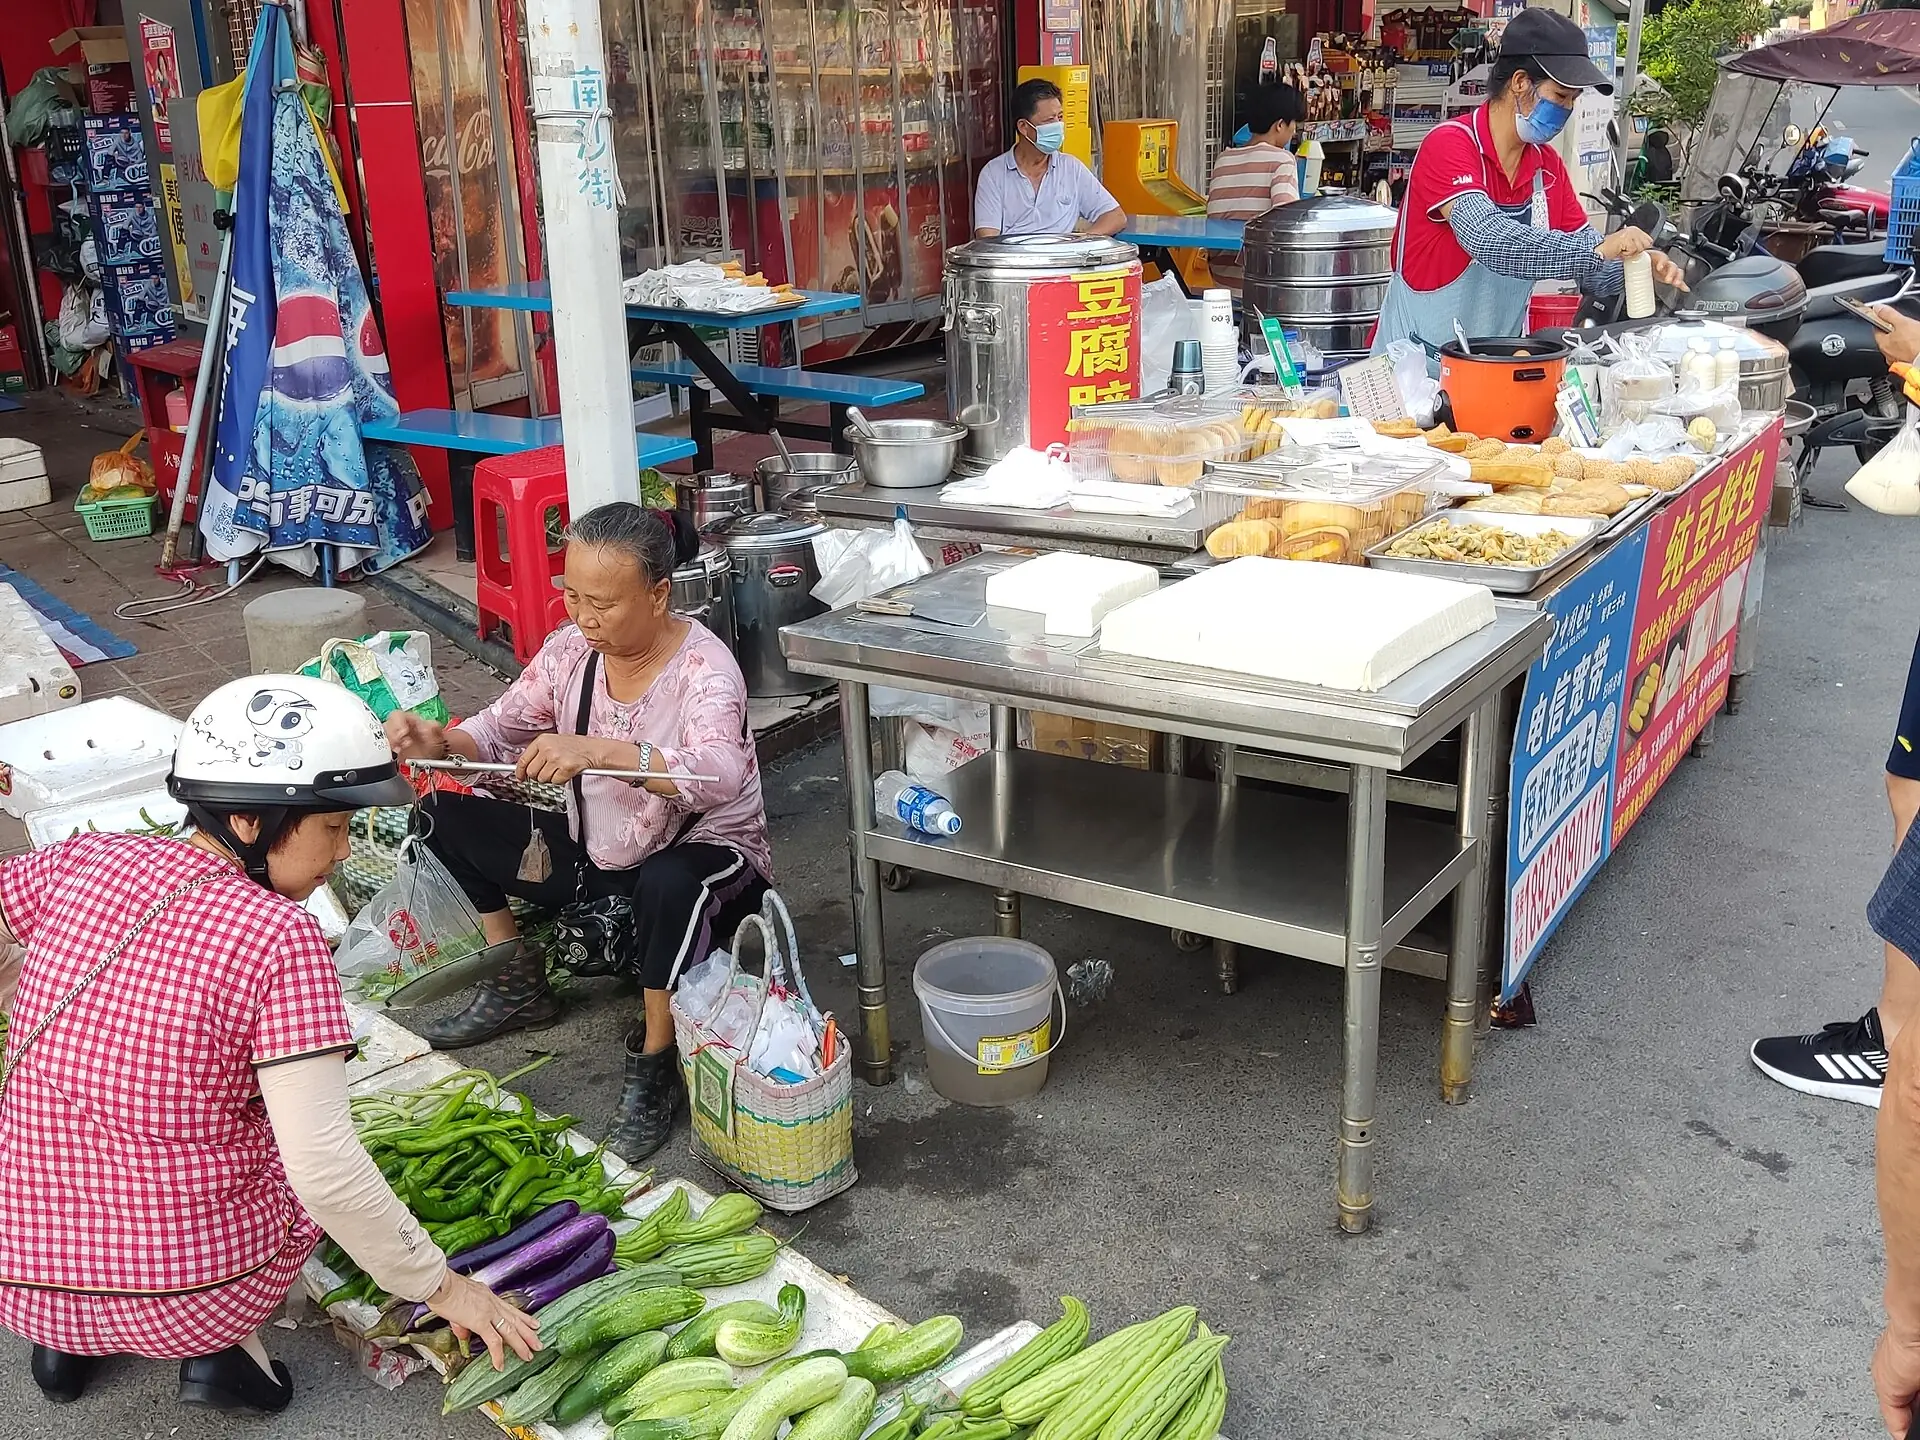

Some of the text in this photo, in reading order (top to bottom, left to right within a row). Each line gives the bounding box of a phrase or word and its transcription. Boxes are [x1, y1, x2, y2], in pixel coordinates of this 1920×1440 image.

[573, 65, 613, 210] 南沙街
[1657, 449, 1765, 600] 纯豆鲜包
[1559, 592, 1594, 644] 中国电信
[1526, 633, 1612, 758] 电信宽带
[1522, 722, 1593, 850] 授权报装点
[1524, 782, 1606, 946] 18923090112
